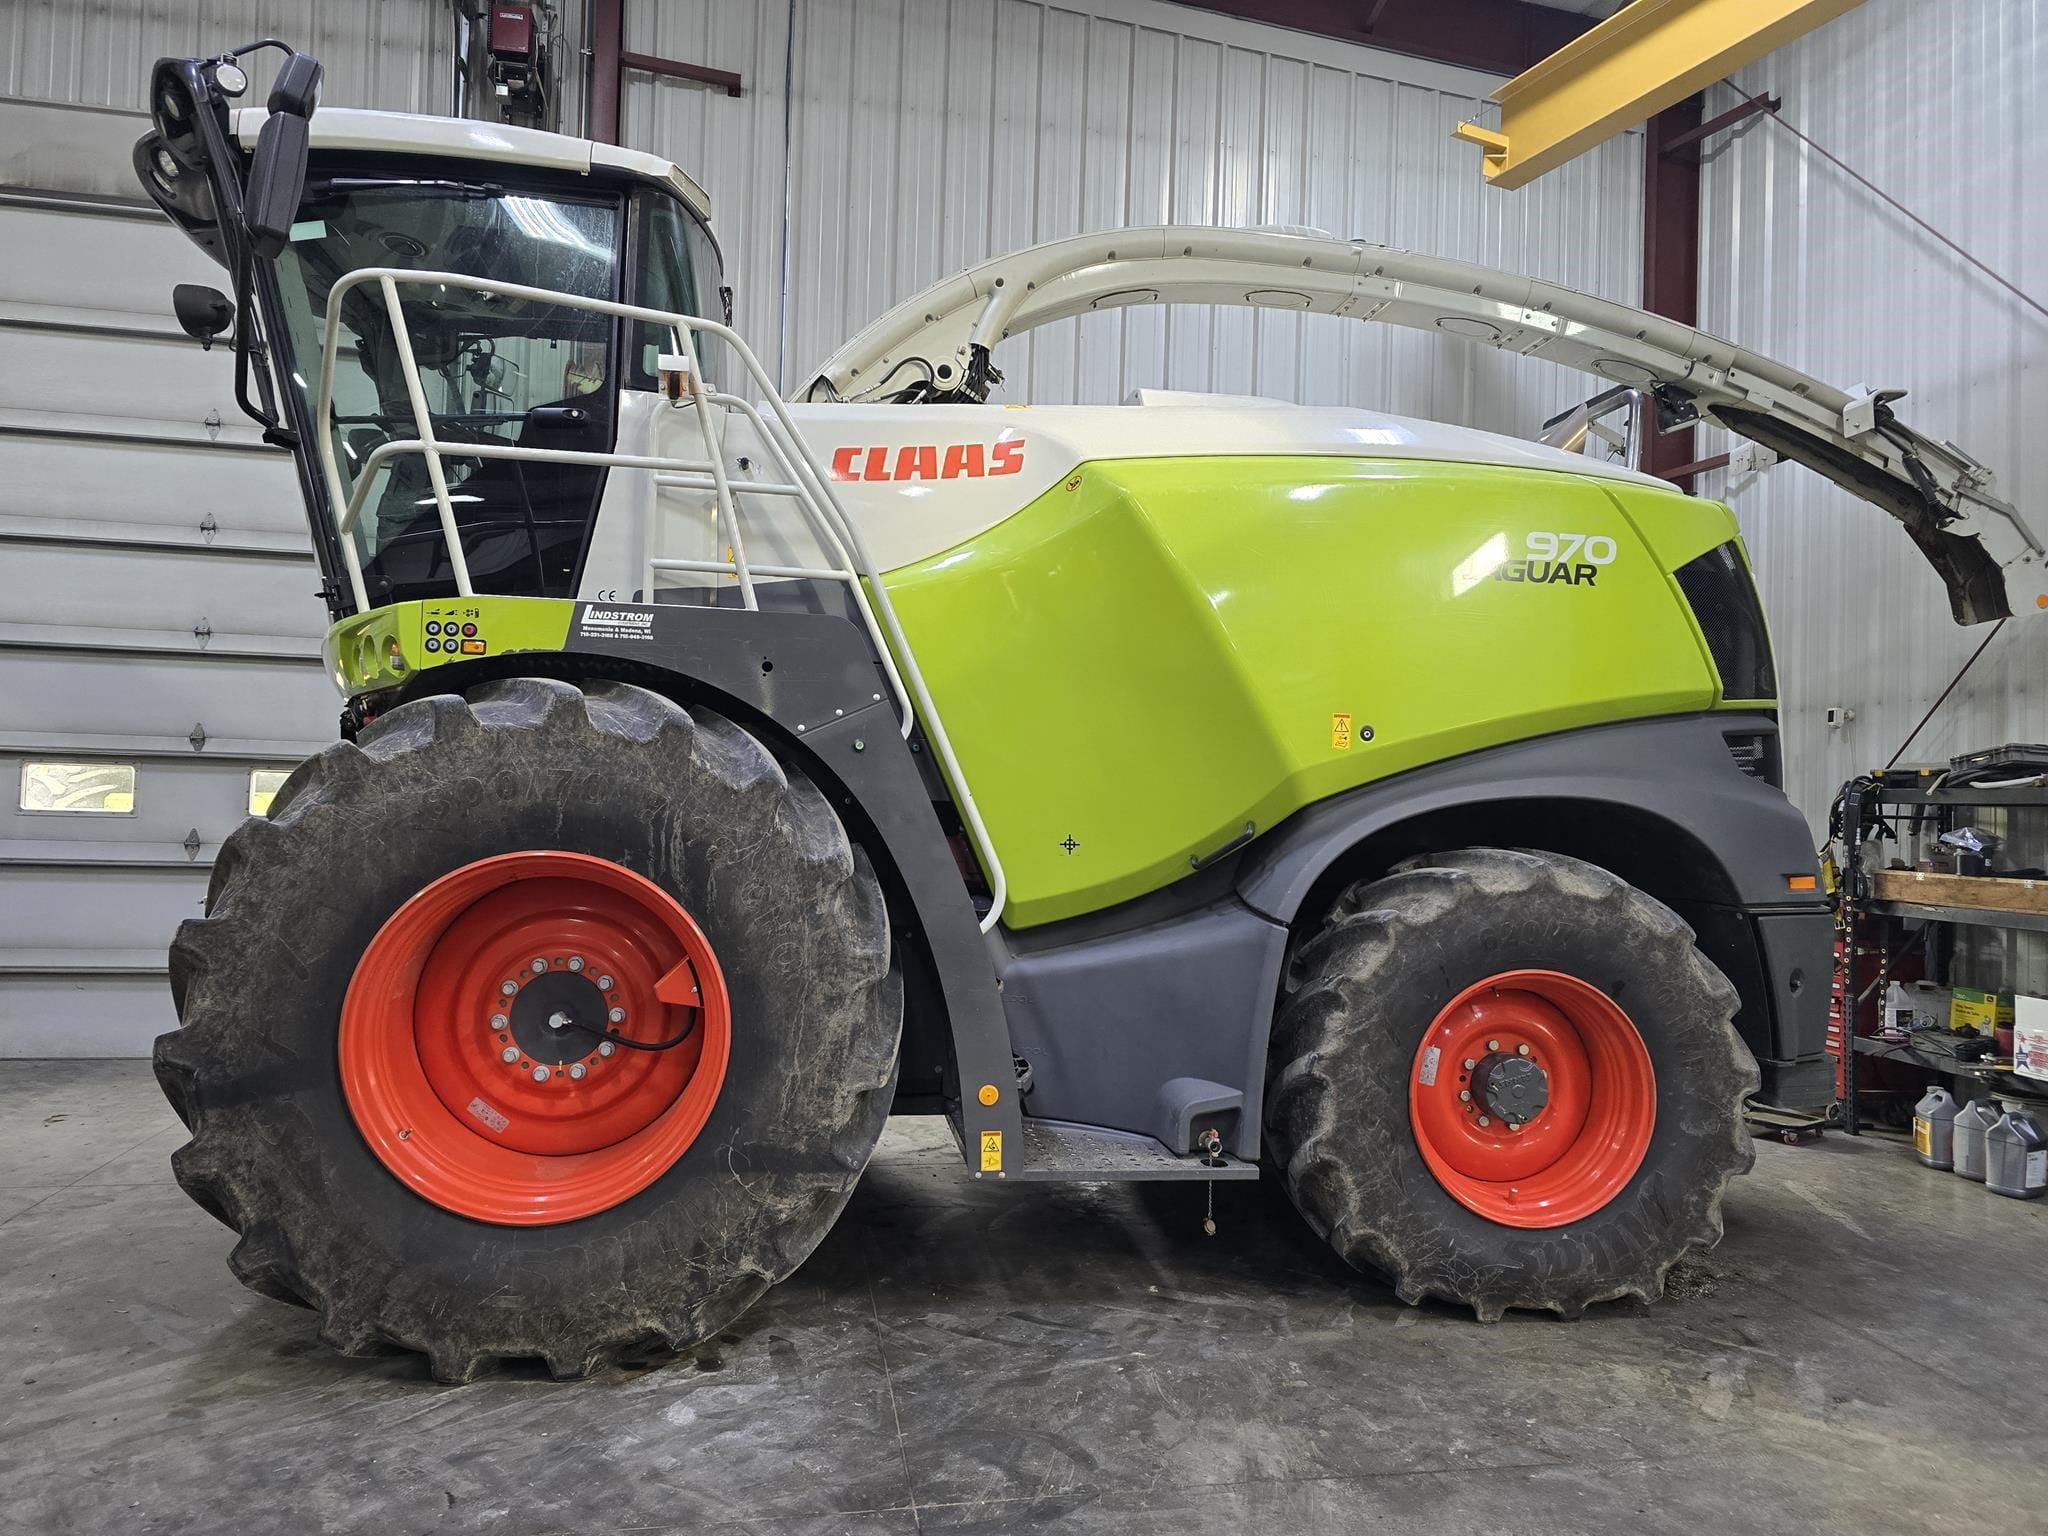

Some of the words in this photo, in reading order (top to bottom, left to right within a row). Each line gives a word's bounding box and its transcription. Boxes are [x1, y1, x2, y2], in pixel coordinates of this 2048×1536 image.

[831, 440, 1026, 482] CLAAS
[1526, 531, 1617, 565] 970
[581, 604, 654, 625] LINDSTROM
